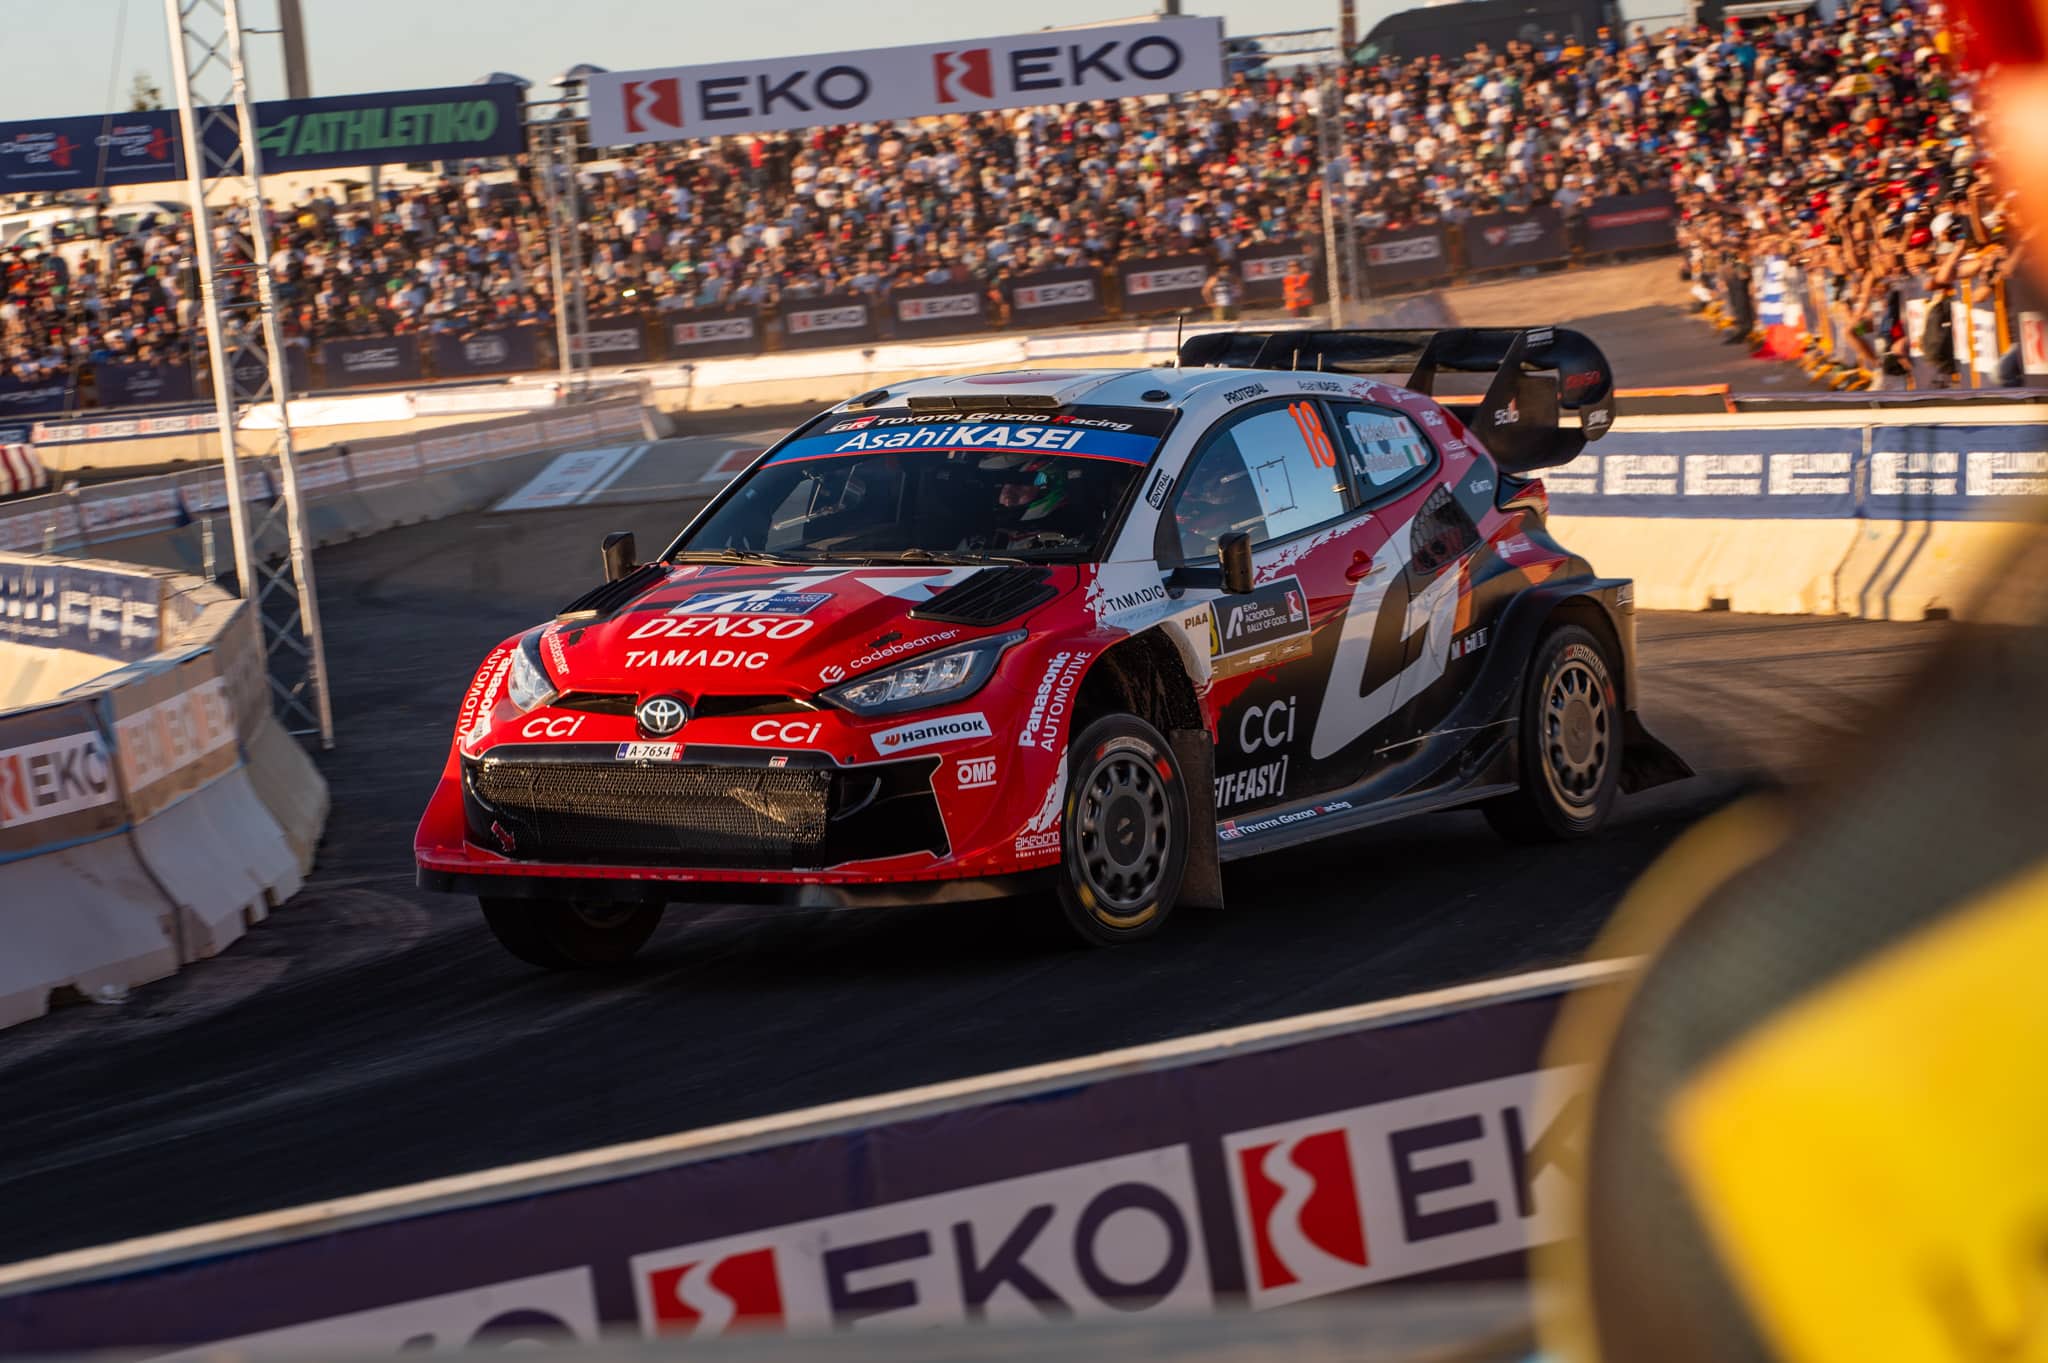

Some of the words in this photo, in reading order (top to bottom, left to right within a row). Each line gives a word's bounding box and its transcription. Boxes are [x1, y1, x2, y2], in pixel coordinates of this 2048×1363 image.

[1008, 36, 1184, 92] EKO
[697, 65, 871, 121] EKO
[297, 101, 498, 155] ATHLETIKO
[703, 319, 748, 338] EKO
[815, 307, 864, 325] EKO
[876, 413, 962, 427] TOYOTA
[965, 411, 1050, 424] GAZOO
[1051, 414, 1134, 432] Racing
[835, 423, 1087, 452] AsahiKASEI
[1288, 401, 1337, 469] 18
[741, 601, 771, 612] 18
[1105, 585, 1166, 613] TAMADIC
[1184, 612, 1209, 630] PIAA
[1244, 608, 1276, 623] ACROPOLIS
[627, 617, 815, 640] DENSO
[624, 650, 769, 669] TAMADIC
[850, 630, 957, 670] codebeamer
[1019, 650, 1071, 747] Panasonic
[1041, 650, 1093, 752] AUTOMOTIVE
[629, 745, 671, 758] A-7654
[27, 742, 108, 806] EKO
[957, 762, 997, 784] OMP
[1238, 819, 1280, 835] TOYOTA
[822, 1180, 1190, 1328] EKO
